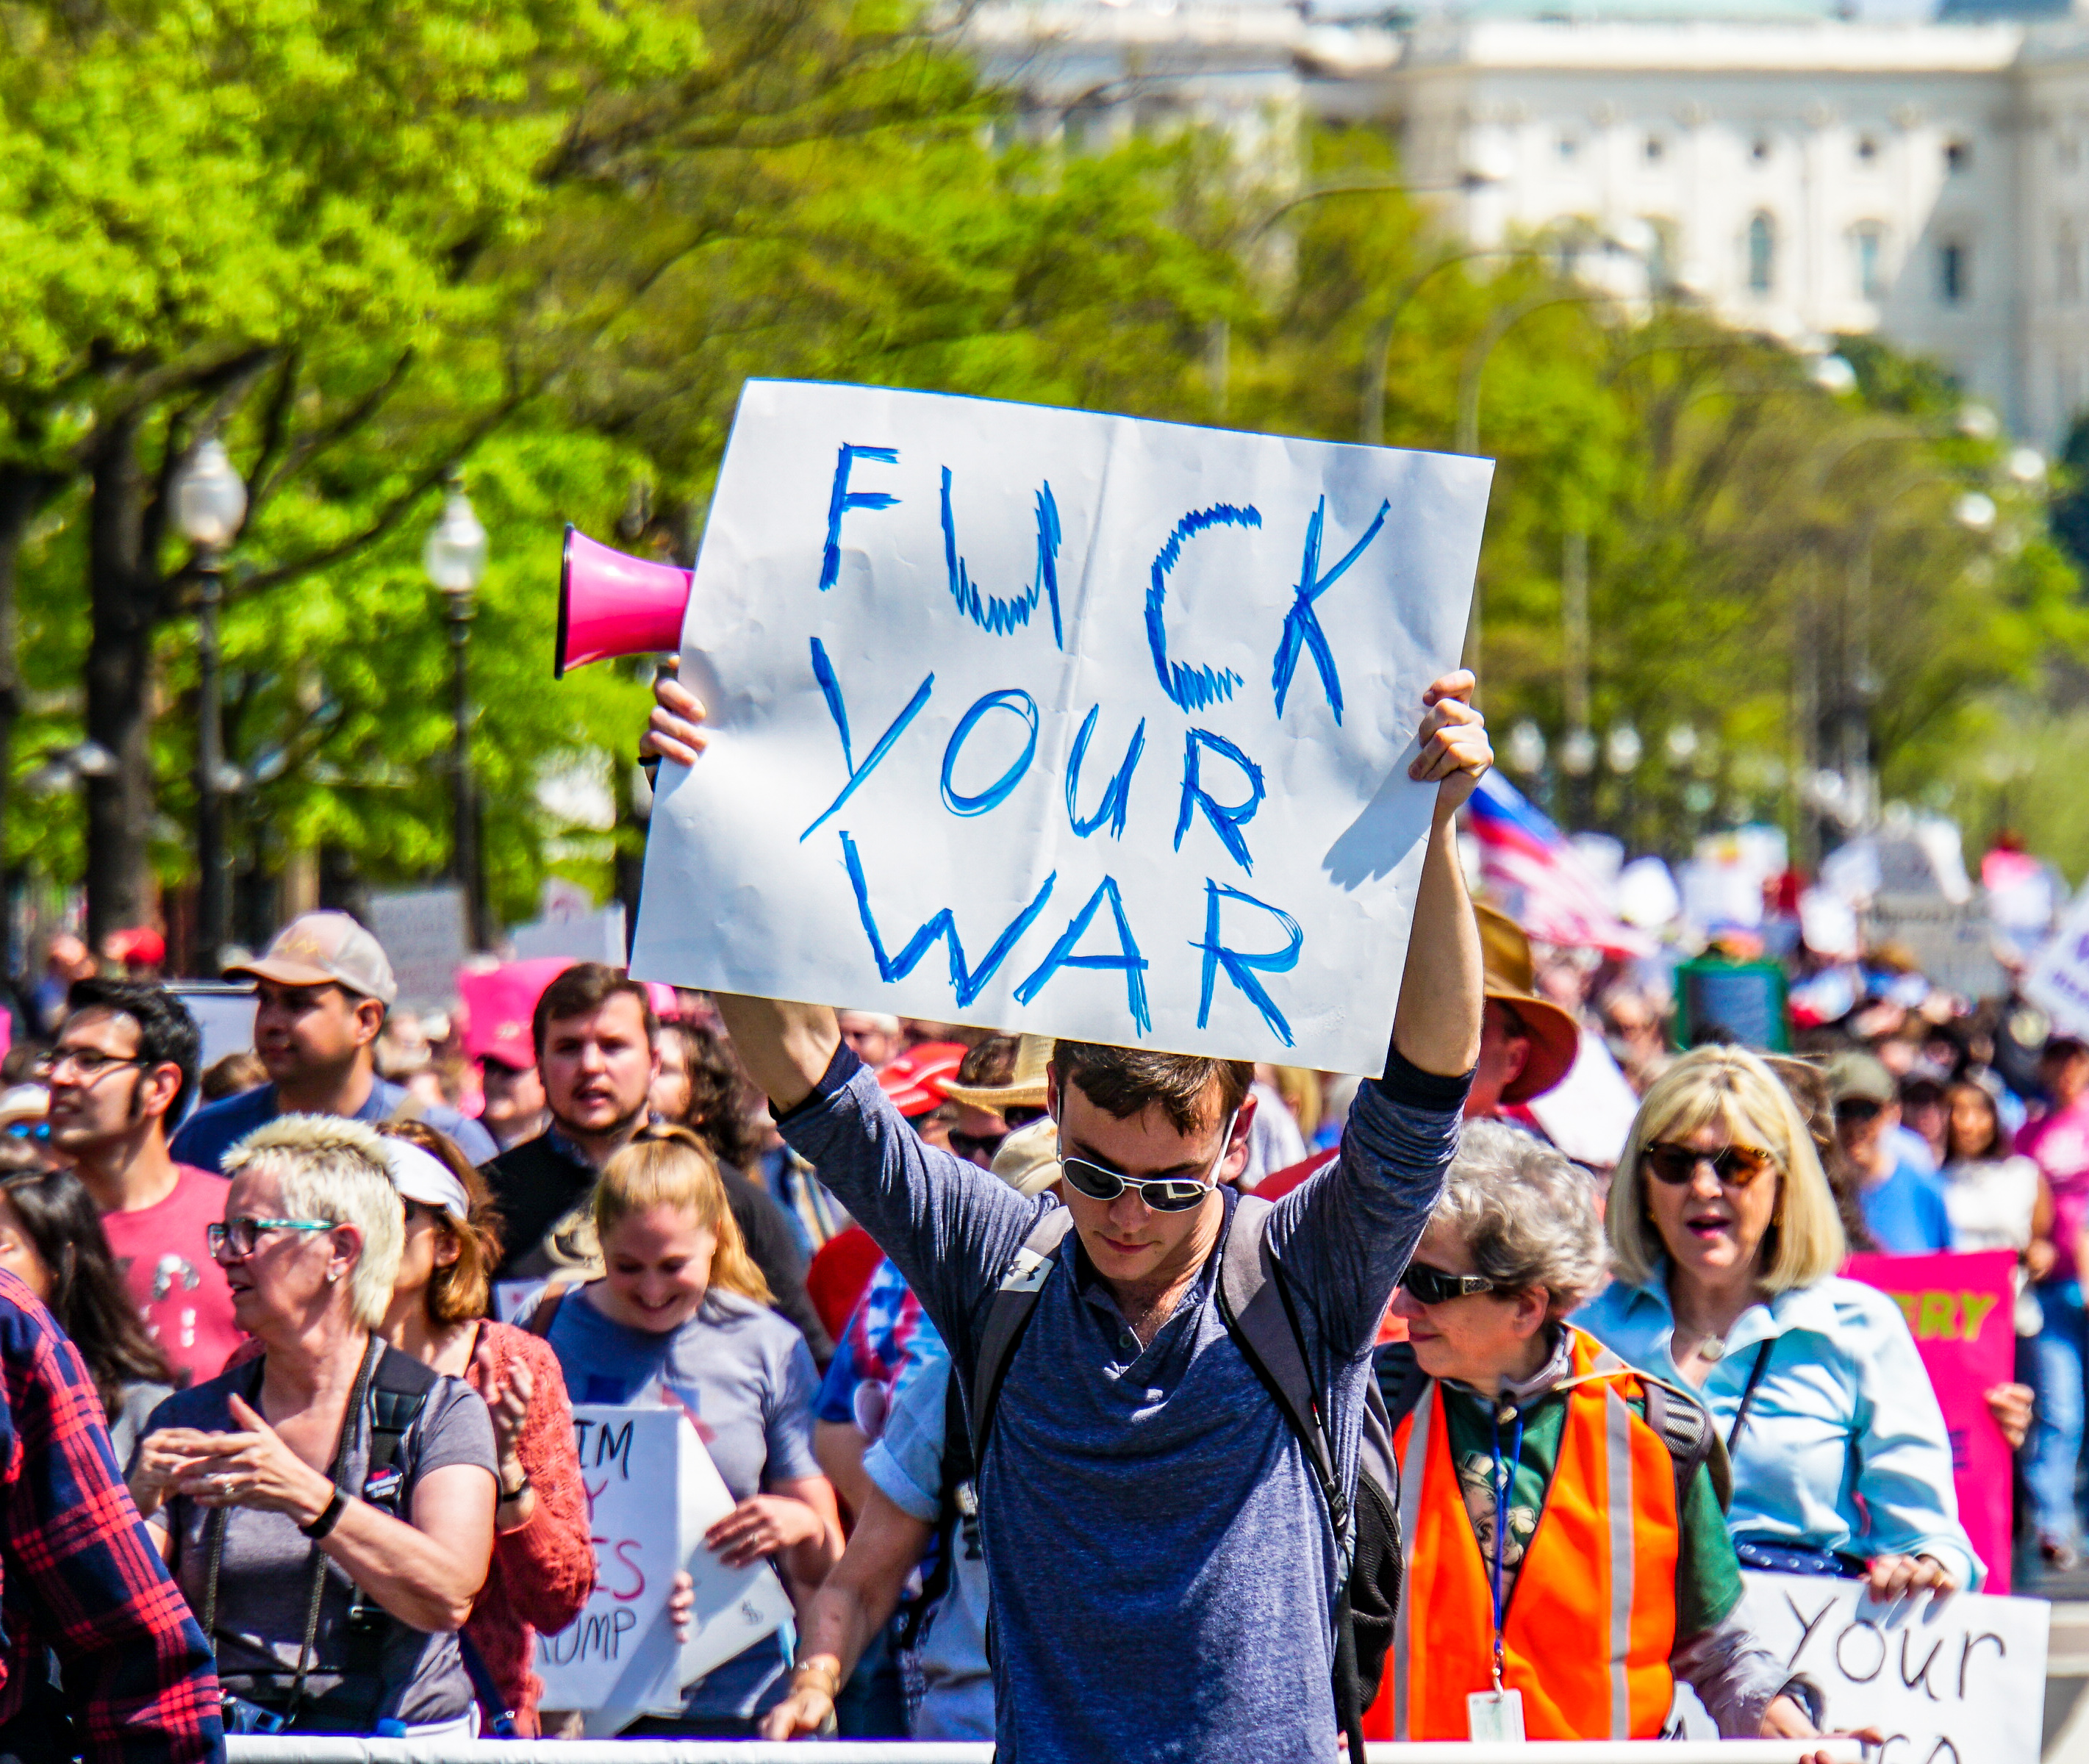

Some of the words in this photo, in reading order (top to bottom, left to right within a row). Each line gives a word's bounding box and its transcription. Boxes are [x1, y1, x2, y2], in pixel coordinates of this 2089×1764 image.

[819, 442, 1391, 727] FUCK
[799, 637, 1266, 878] YOUR
[838, 831, 1304, 1048] WAR
